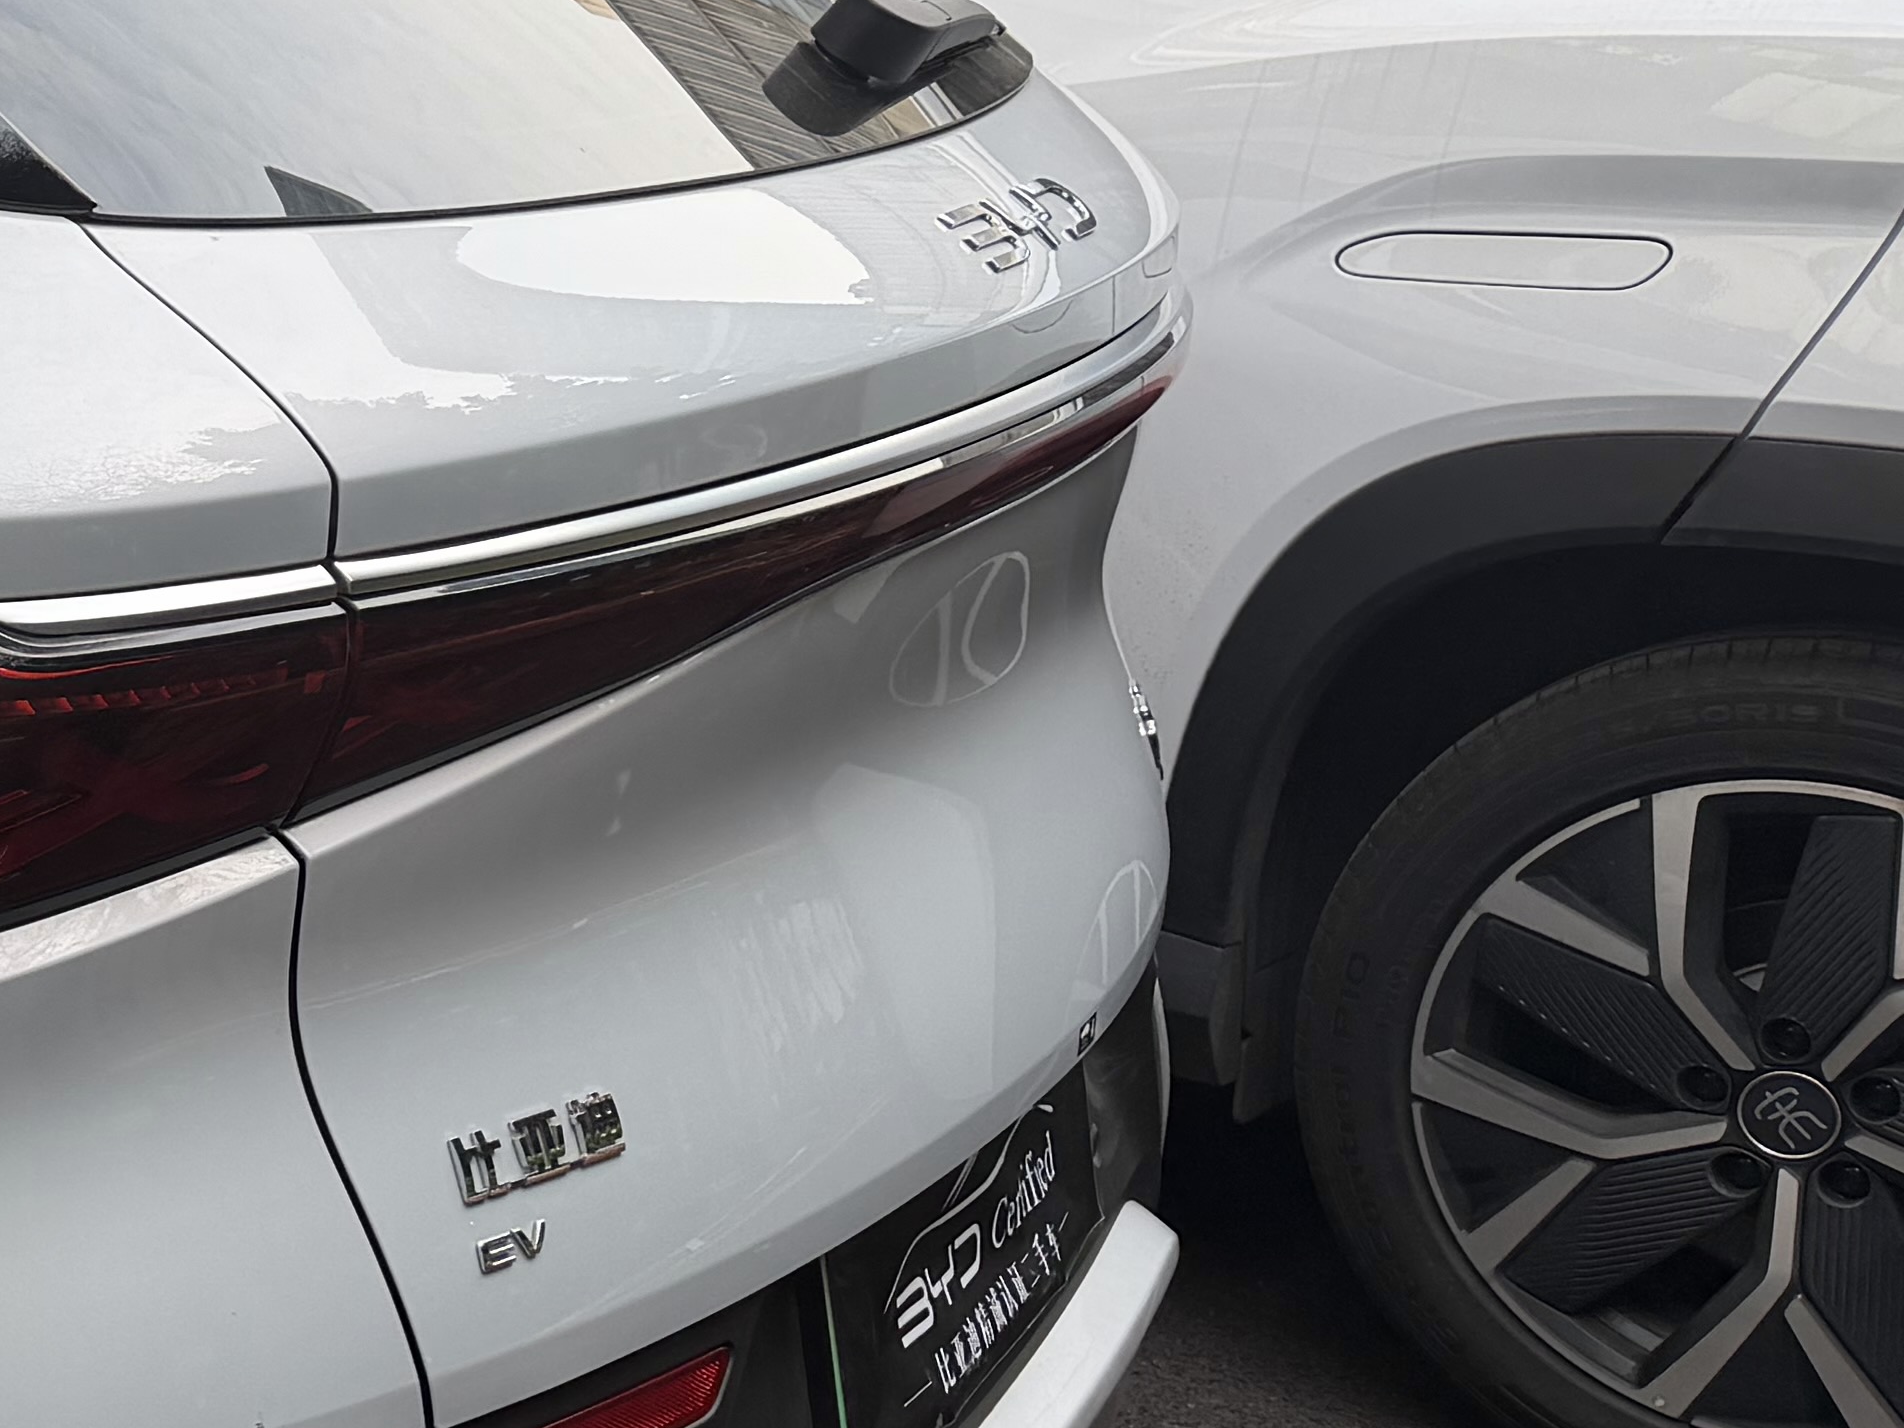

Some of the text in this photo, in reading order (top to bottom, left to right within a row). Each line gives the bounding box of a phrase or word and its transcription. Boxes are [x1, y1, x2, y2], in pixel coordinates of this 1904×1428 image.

[446, 1091, 627, 1207] 比亚迪
[991, 1130, 1057, 1250] Certified
[475, 1218, 546, 1275] EV
